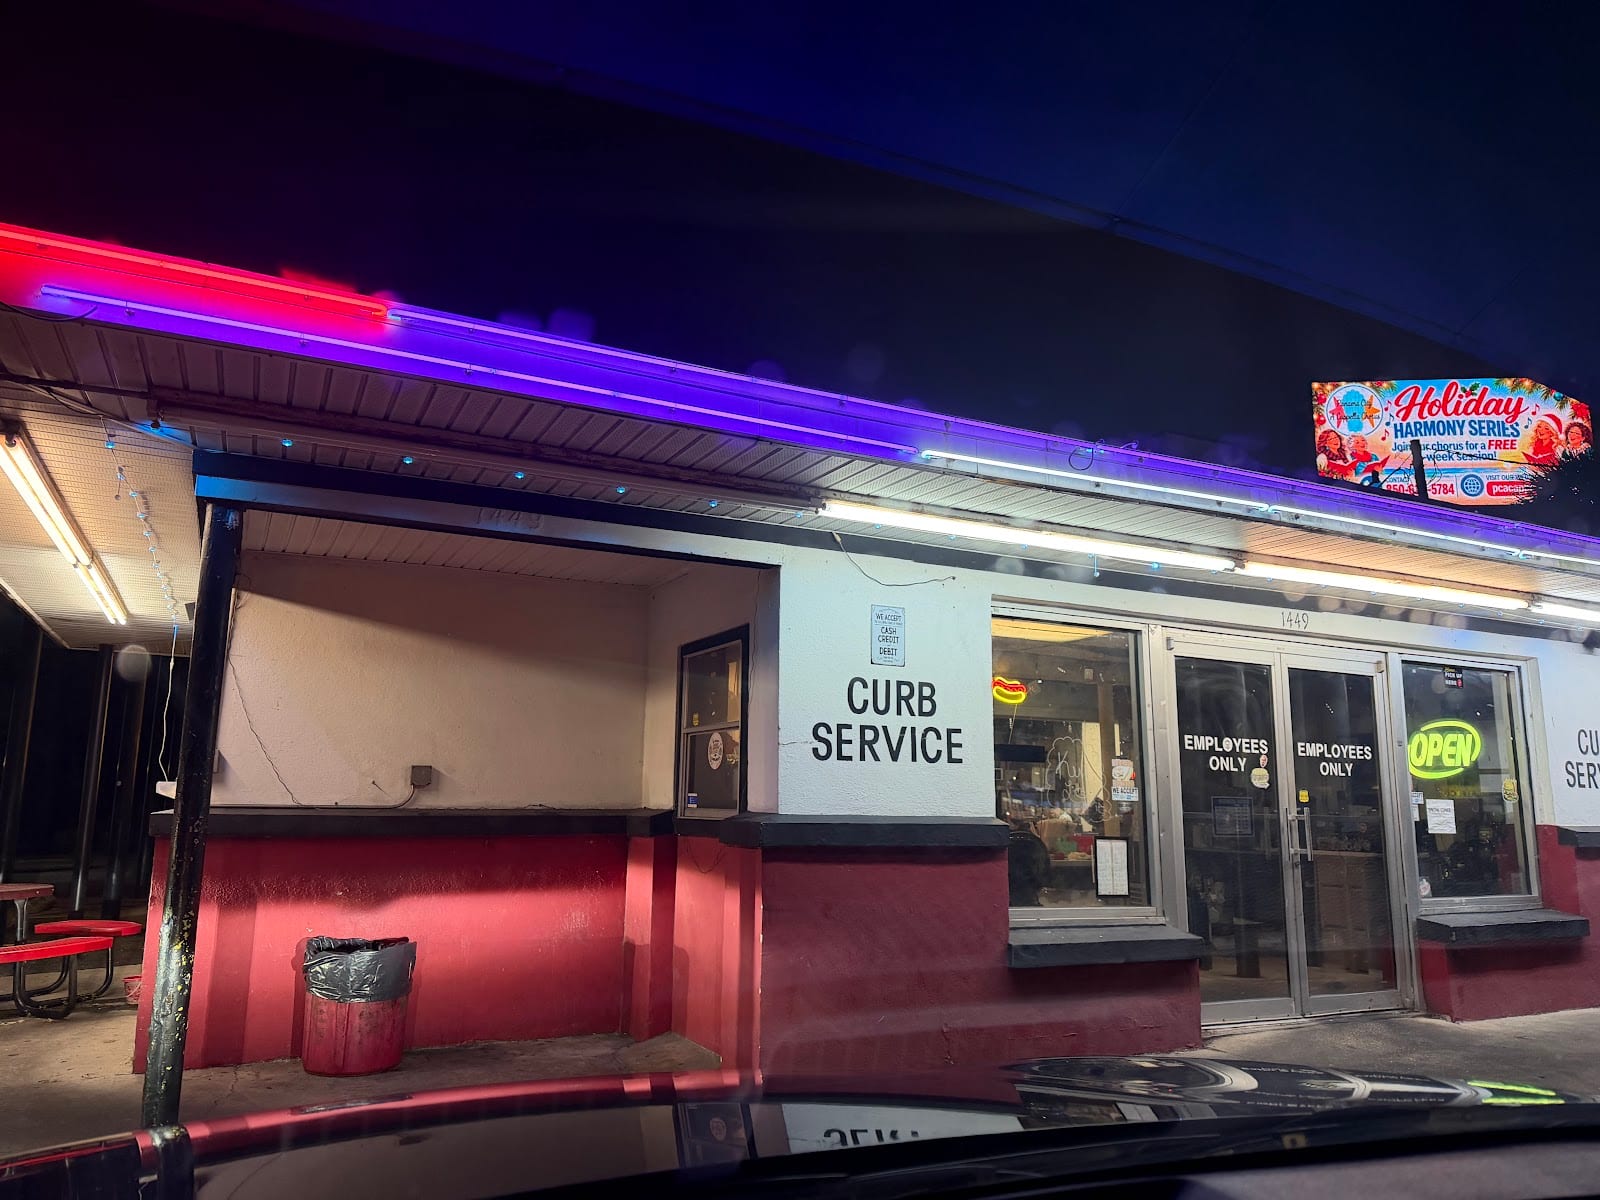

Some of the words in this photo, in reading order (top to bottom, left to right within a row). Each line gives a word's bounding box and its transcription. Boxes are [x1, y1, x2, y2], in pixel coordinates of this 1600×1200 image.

[1394, 381, 1529, 424] Holiday
[1394, 420, 1466, 439] HARMONY
[1469, 420, 1521, 438] SERIES
[1432, 441, 1464, 451] chorus
[1465, 441, 1480, 450] for
[1488, 439, 1517, 450] FREE
[1422, 452, 1455, 461] -week
[875, 613, 884, 621] WE
[885, 614, 902, 622] ACCEPT
[1281, 611, 1310, 630] 1449
[878, 634, 900, 644] CREDIT
[881, 626, 897, 635] CASH
[880, 646, 898, 656] DEBIT
[847, 676, 937, 717] CURB
[811, 722, 963, 763] SERVICE
[1184, 734, 1269, 755] EMPLOYEES
[1297, 742, 1372, 760] EMPLOYEES
[1410, 732, 1472, 767] OPEN
[1209, 755, 1246, 772] ONLY
[1320, 761, 1353, 777] ONLY
